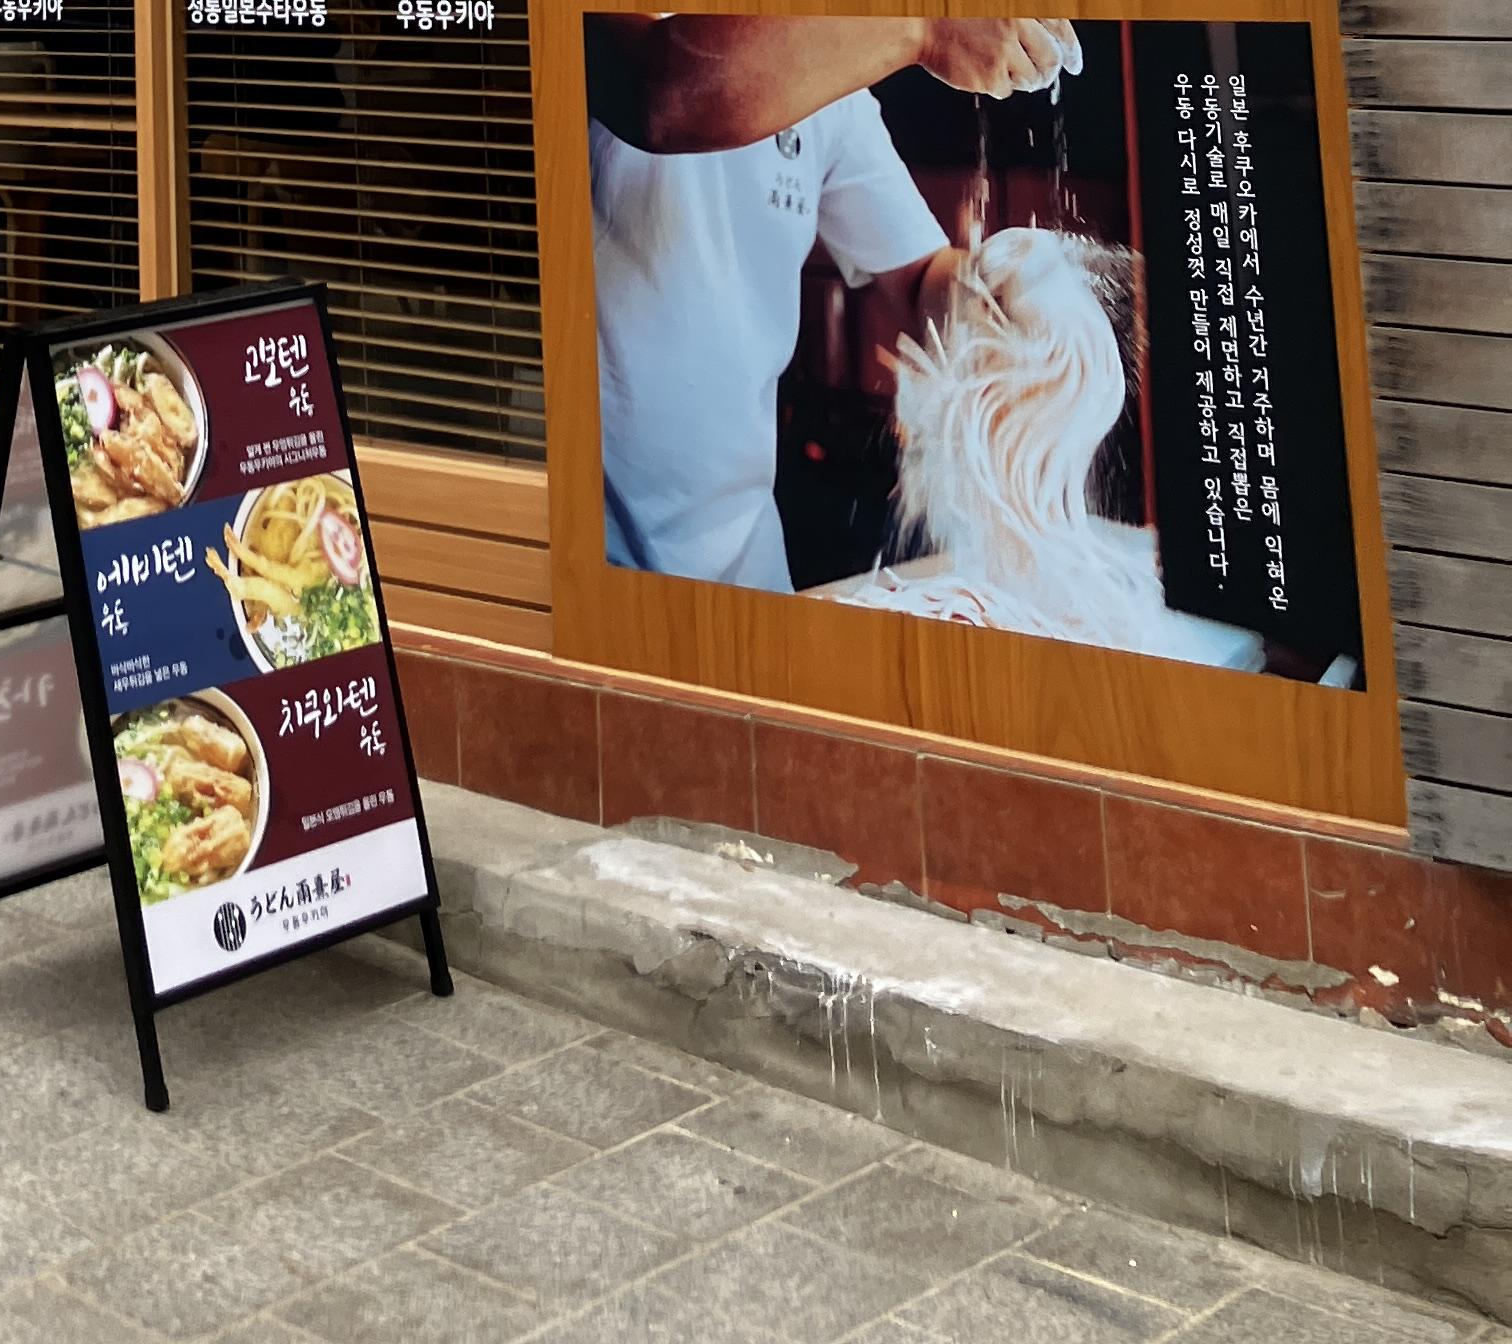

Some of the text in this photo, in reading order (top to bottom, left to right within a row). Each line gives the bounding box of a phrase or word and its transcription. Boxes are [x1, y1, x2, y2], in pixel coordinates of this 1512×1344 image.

[396, 0, 495, 31] 우동우키야
[1201, 74, 1253, 521] 우동기술로 매일 직접 제면하고 직접뽑은
[1173, 73, 1229, 590] 우동 다시로 정성껏 만들어 제공하고 있습니다.
[1228, 74, 1289, 611] 일본 후쿠오카에서 수년간 거주하며 몸에 익혀온
[245, 334, 310, 387] 고보텐
[289, 382, 314, 417] 우동
[96, 535, 196, 592] 에비텐
[101, 600, 129, 637] 우동
[278, 676, 379, 738] 치쿠와텐
[359, 720, 386, 756] 우동
